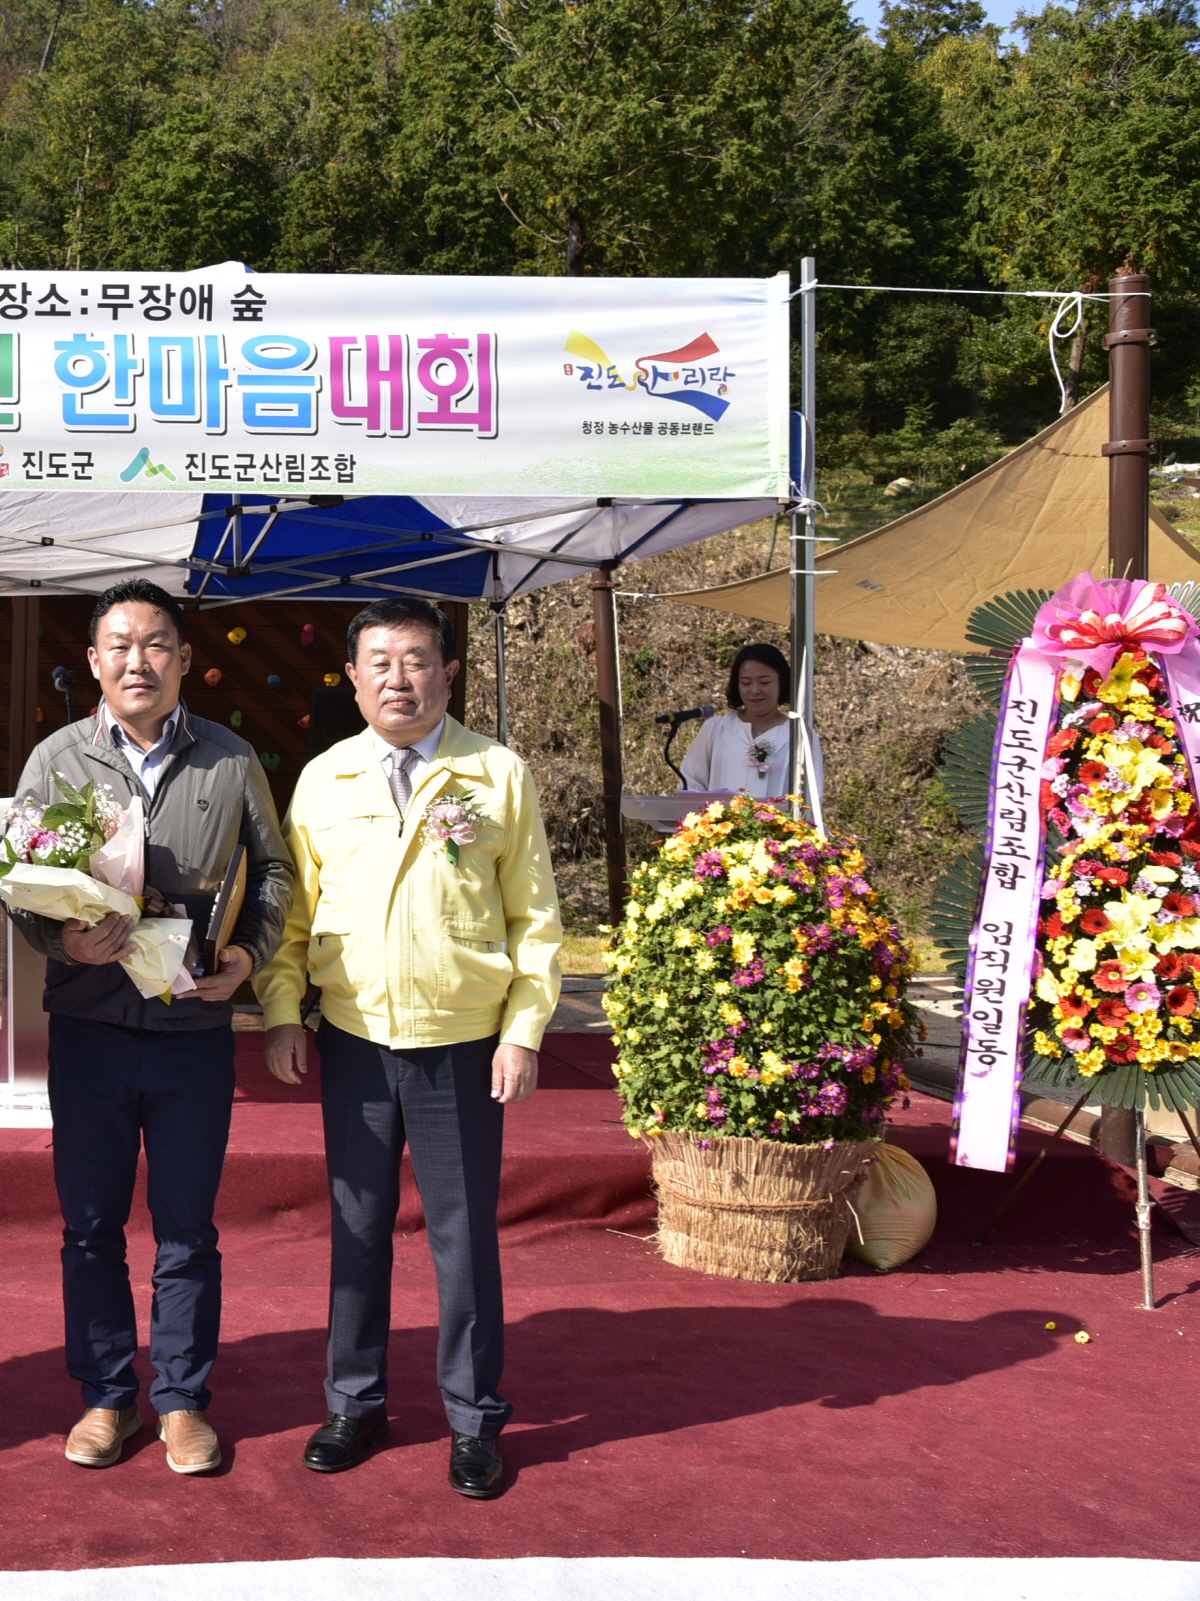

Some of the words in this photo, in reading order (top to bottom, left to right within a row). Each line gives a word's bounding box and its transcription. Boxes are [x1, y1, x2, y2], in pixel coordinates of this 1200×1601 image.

[230, 284, 267, 322] 숲
[581, 420, 605, 436] 청정
[607, 420, 655, 436] 농수산물
[657, 421, 715, 437] 공동브랜드
[21, 450, 96, 481] 진도군
[184, 452, 358, 484] 진도군산림조합
[967, 919, 1014, 1067] 임직원일동
